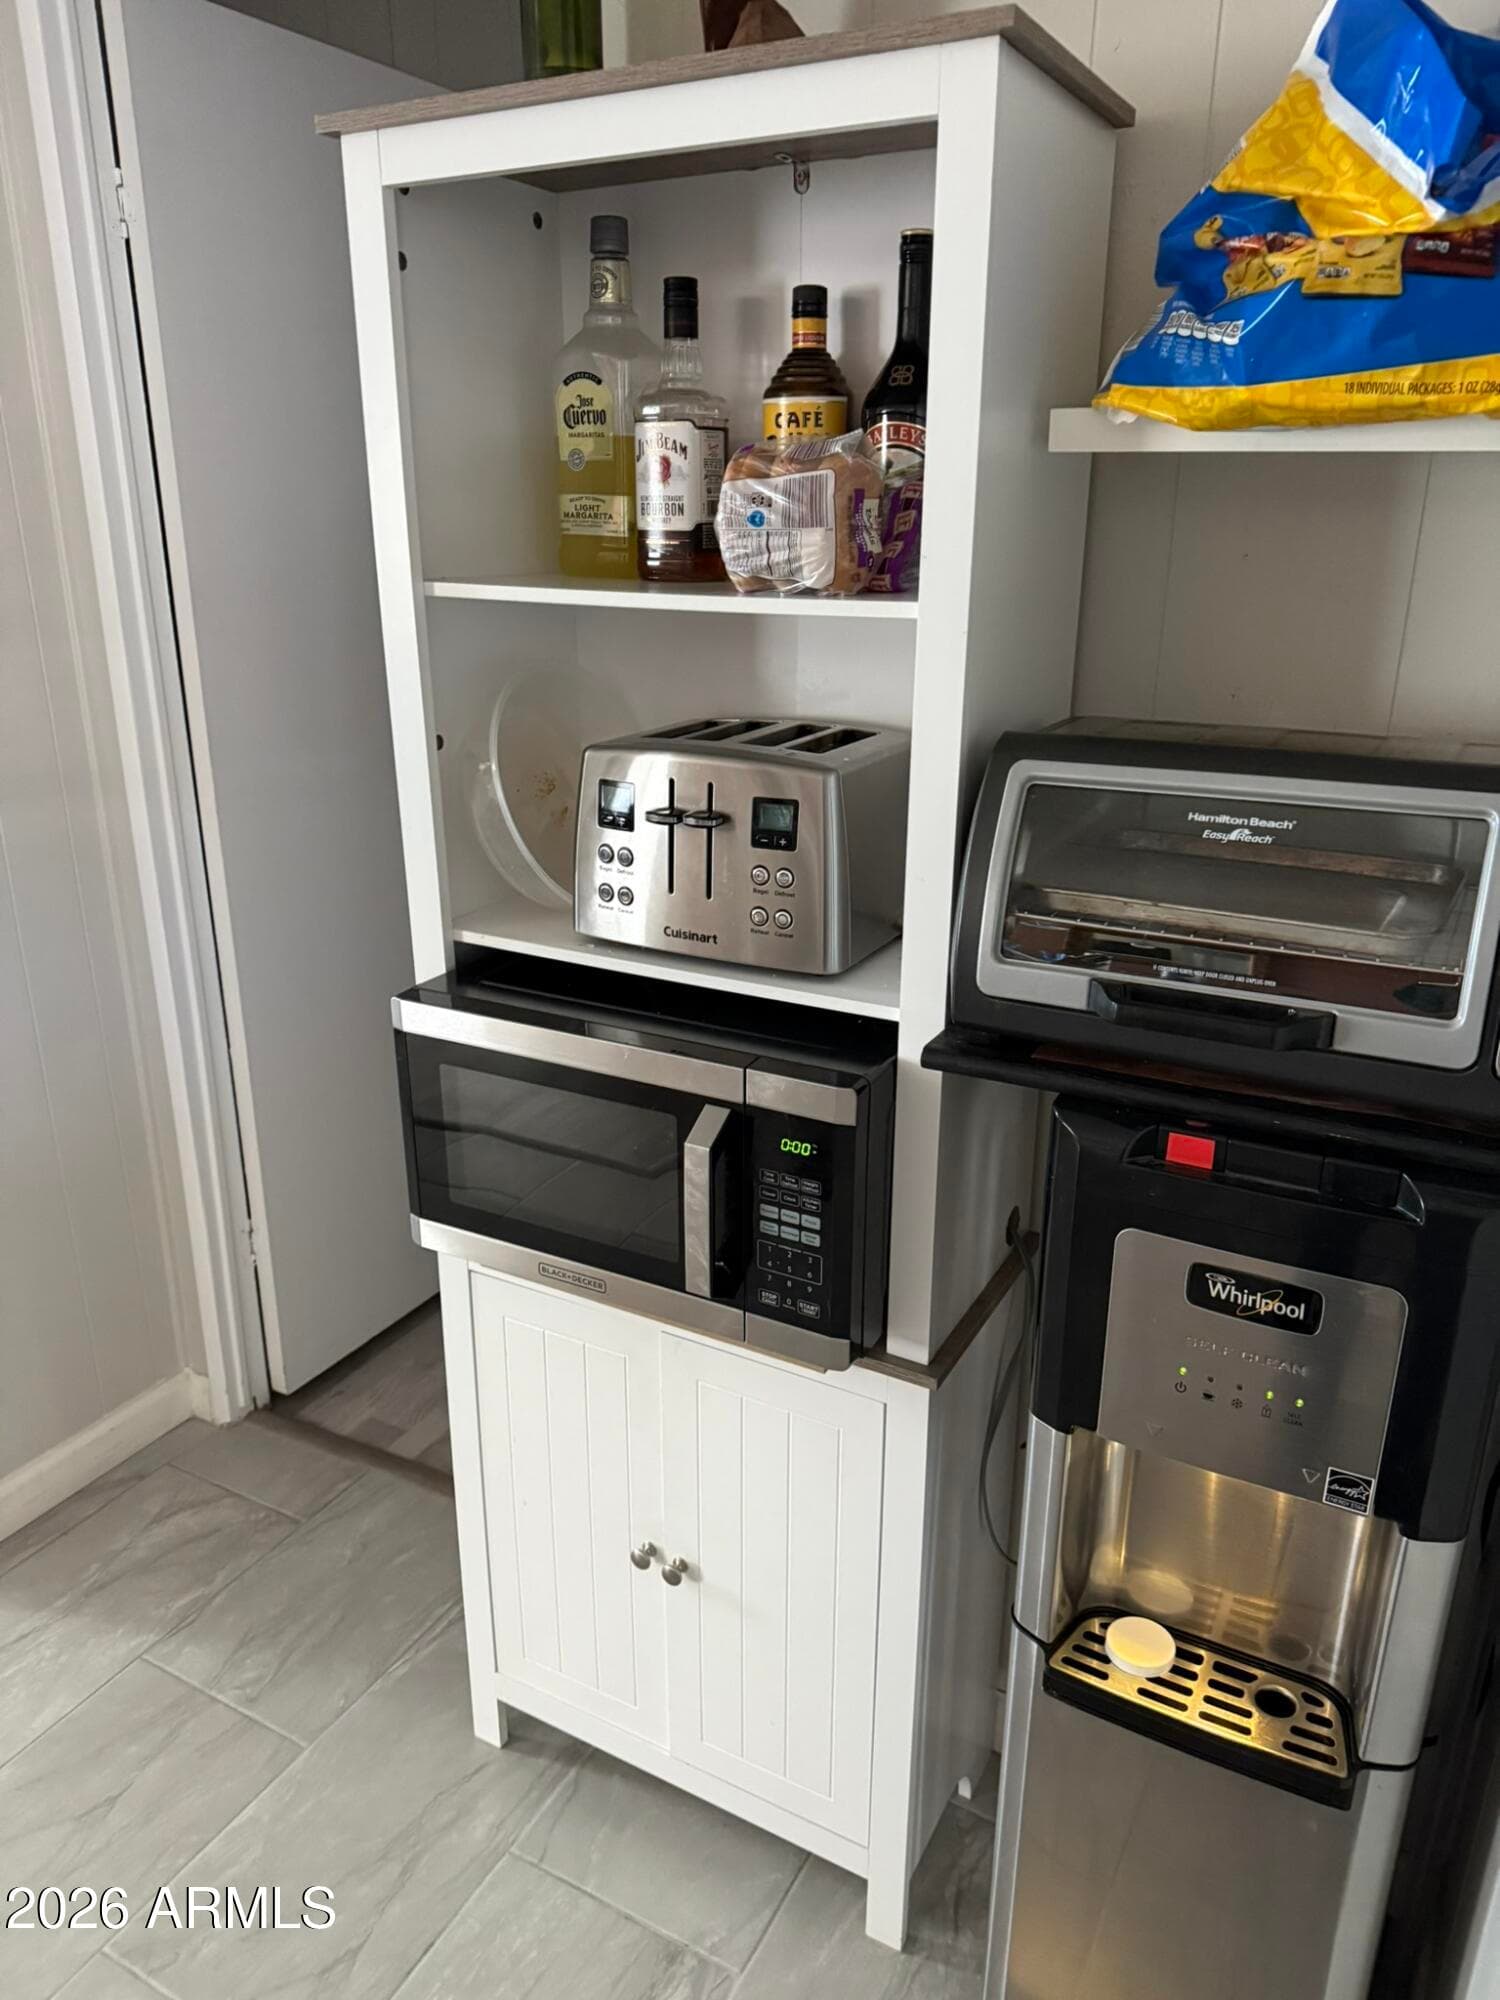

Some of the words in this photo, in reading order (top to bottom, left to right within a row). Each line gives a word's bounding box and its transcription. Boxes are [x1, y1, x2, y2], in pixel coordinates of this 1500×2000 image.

[1344, 382, 1355, 394] 18
[1355, 382, 1406, 395] INDIVIDUAL
[1407, 382, 1456, 395] PACKAGES:
[1458, 382, 1463, 394] 1
[1466, 381, 1479, 394] OZ
[563, 404, 607, 429] Cuervo
[775, 406, 824, 429] CAFÉ
[656, 432, 688, 460] BEAM
[563, 512, 613, 520] MARGARITA
[574, 504, 600, 512] LIGHT
[640, 503, 685, 516] BOURBON
[1187, 811, 1248, 826] Hamilton
[663, 925, 718, 944] Cuisinart
[780, 1138, 811, 1156] 0:00
[1208, 1279, 1305, 1321] Whirlpool
